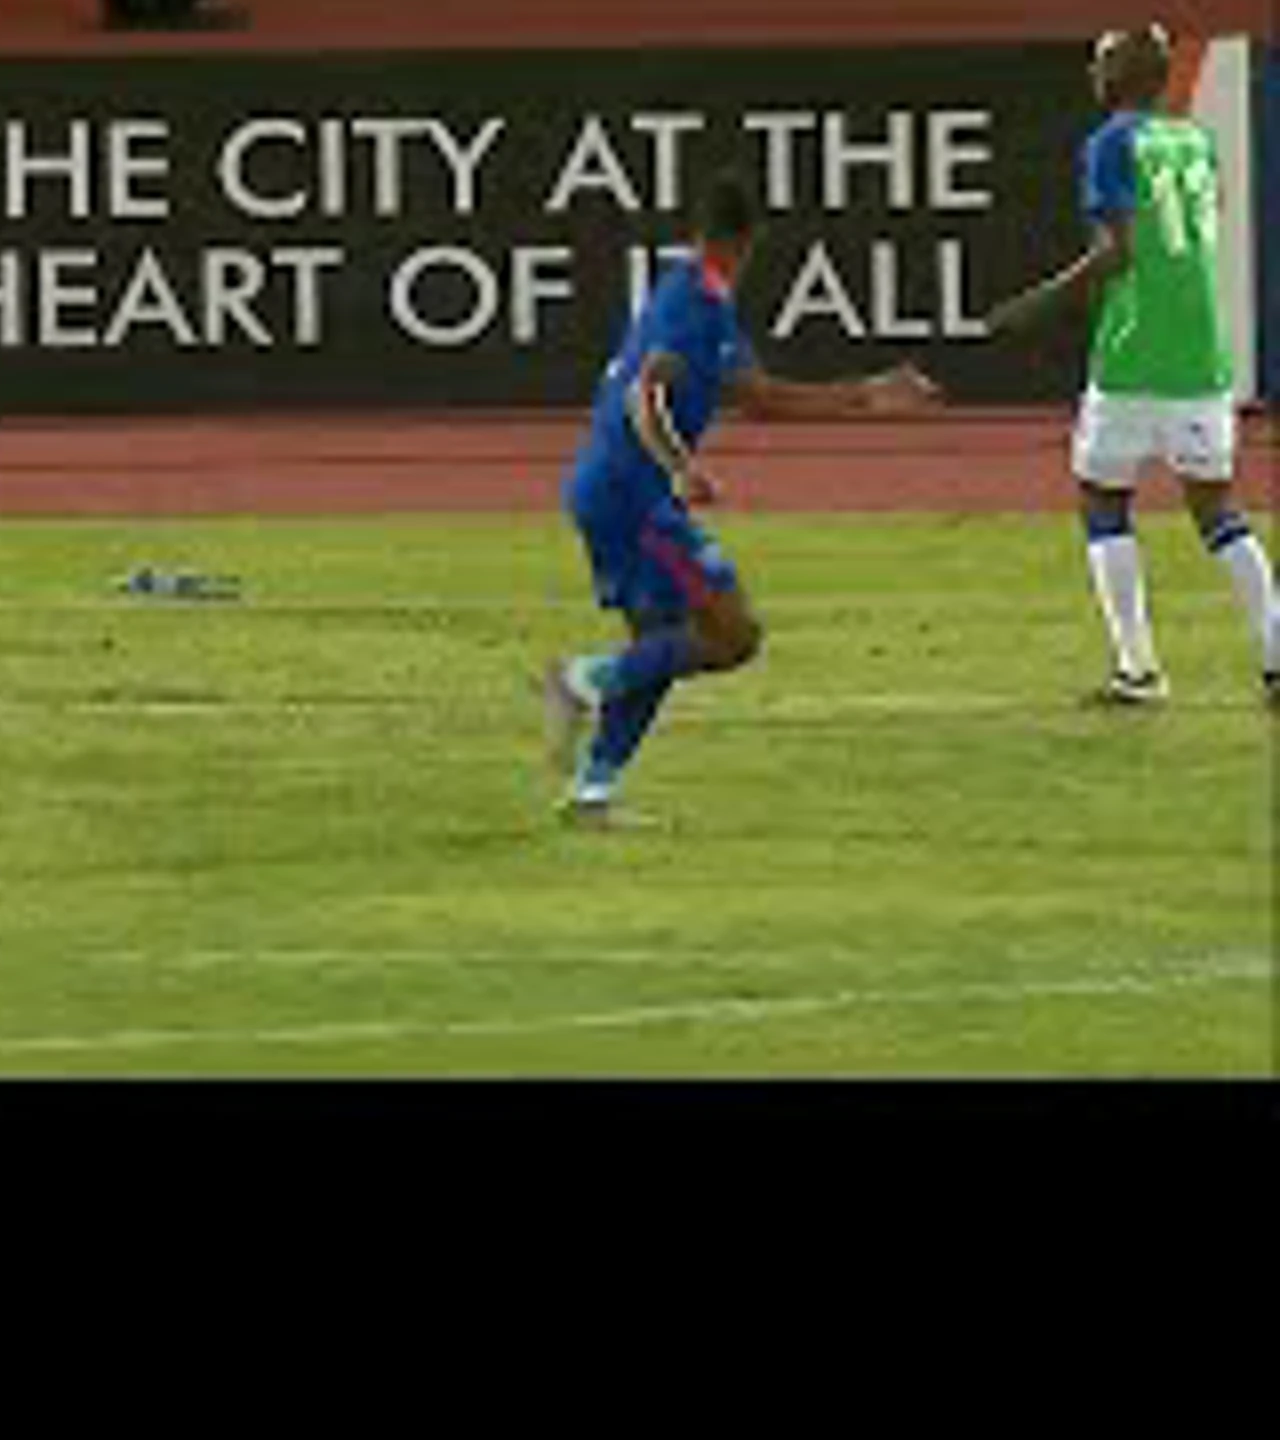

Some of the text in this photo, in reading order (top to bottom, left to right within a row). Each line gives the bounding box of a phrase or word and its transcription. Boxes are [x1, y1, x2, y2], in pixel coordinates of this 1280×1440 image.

[216, 117, 505, 218] CITY
[544, 111, 705, 213] AT
[743, 109, 994, 210] THE
[390, 245, 574, 346] OF
[771, 239, 989, 339] ALL
